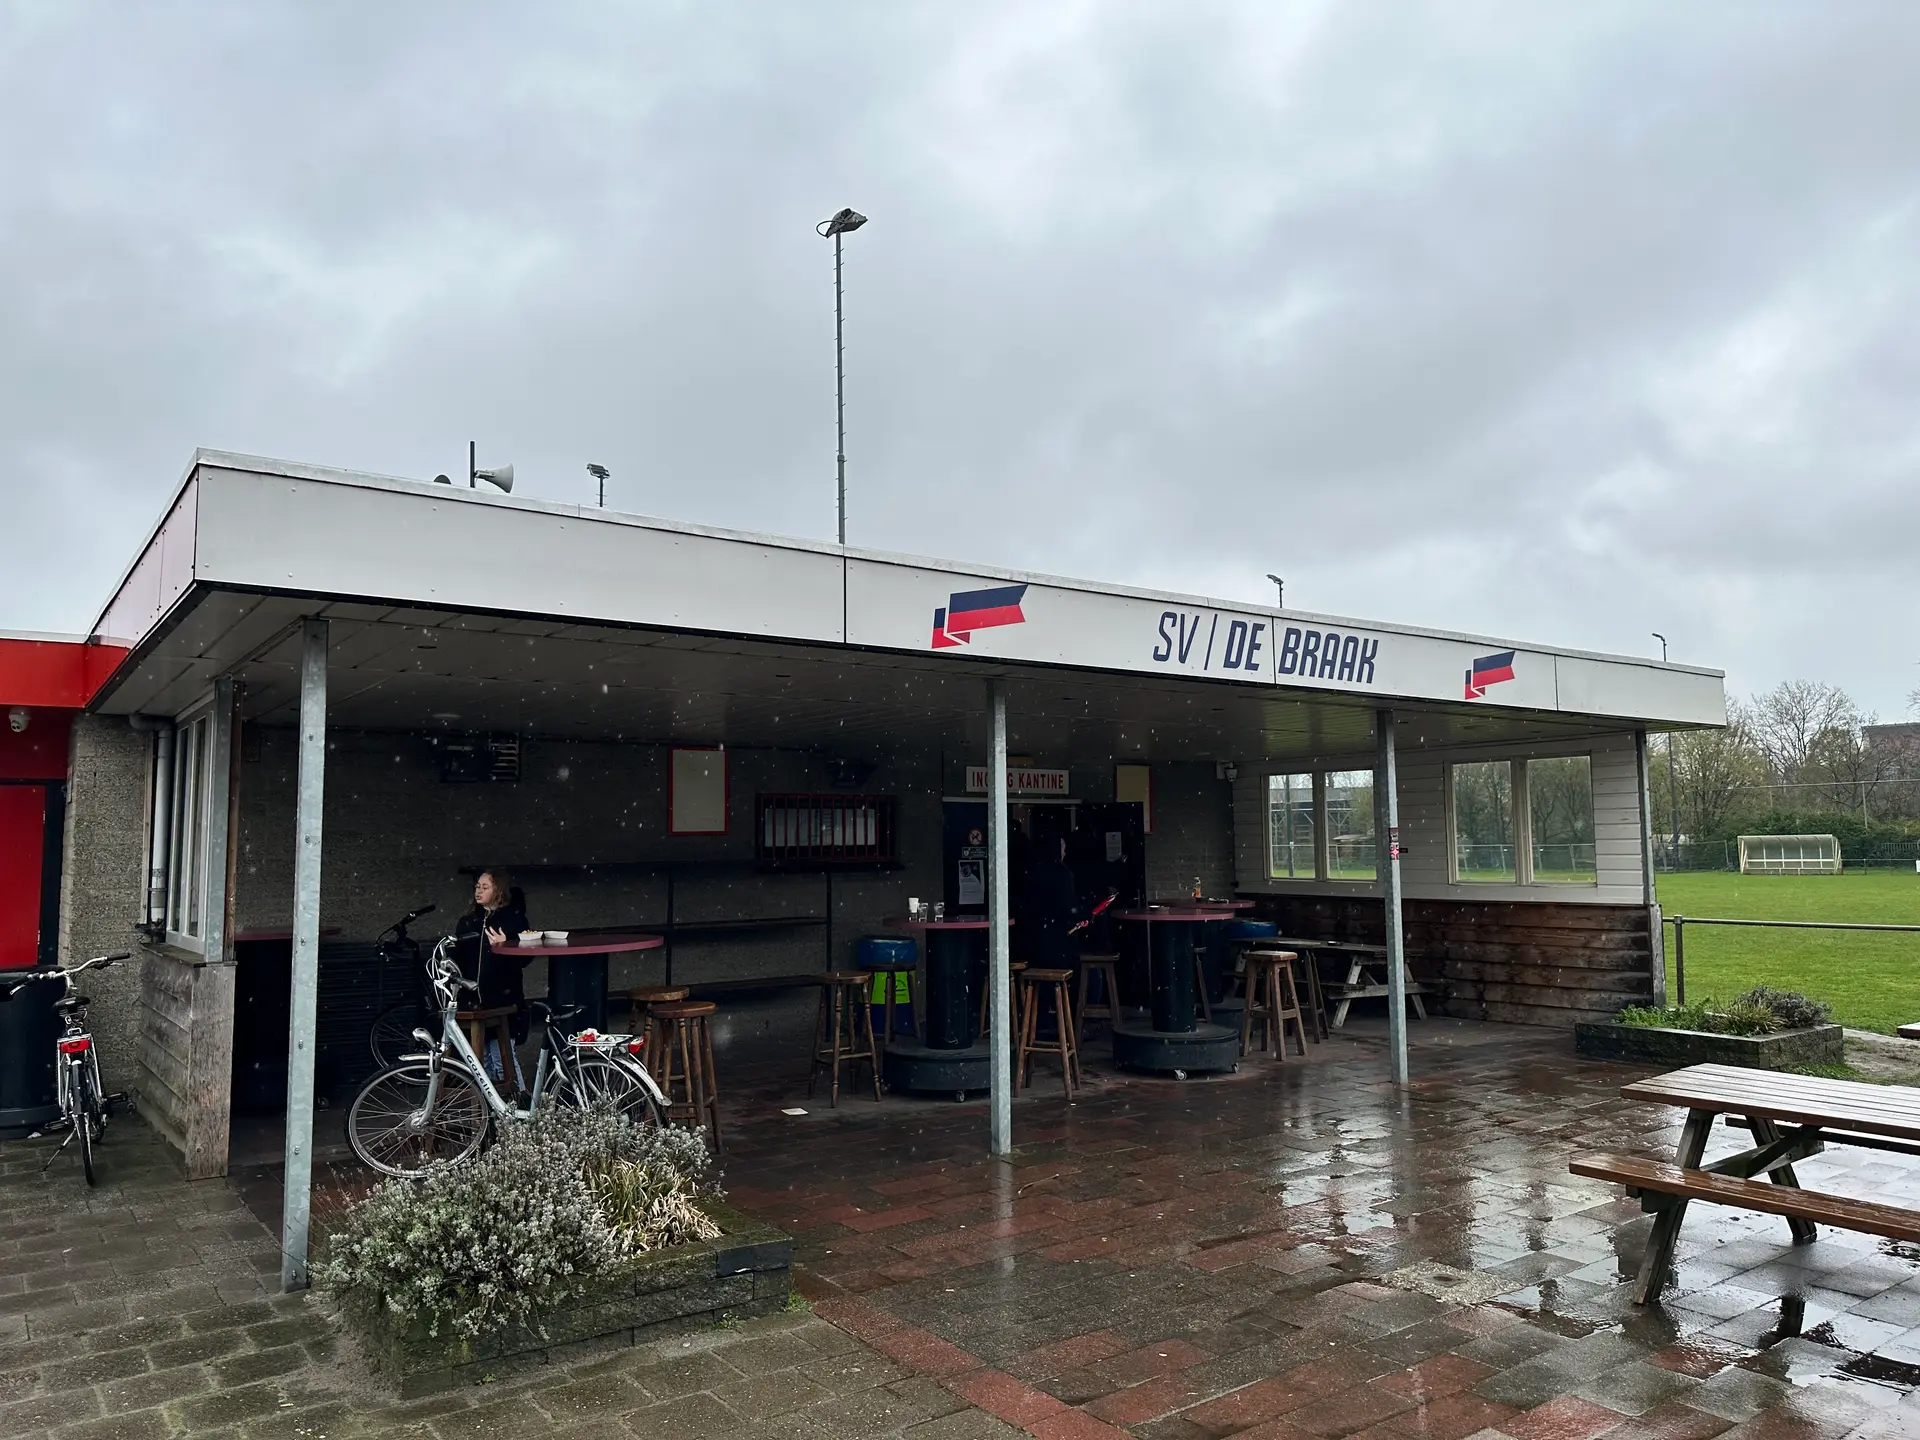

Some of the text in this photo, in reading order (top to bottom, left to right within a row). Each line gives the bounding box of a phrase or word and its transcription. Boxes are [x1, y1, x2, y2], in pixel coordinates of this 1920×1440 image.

[1152, 611, 1200, 664] SV
[1223, 620, 1266, 671] DE
[1278, 627, 1379, 684] BRAAK
[1018, 773, 1064, 789] KANTINE
[466, 1054, 493, 1098] Gazelle
